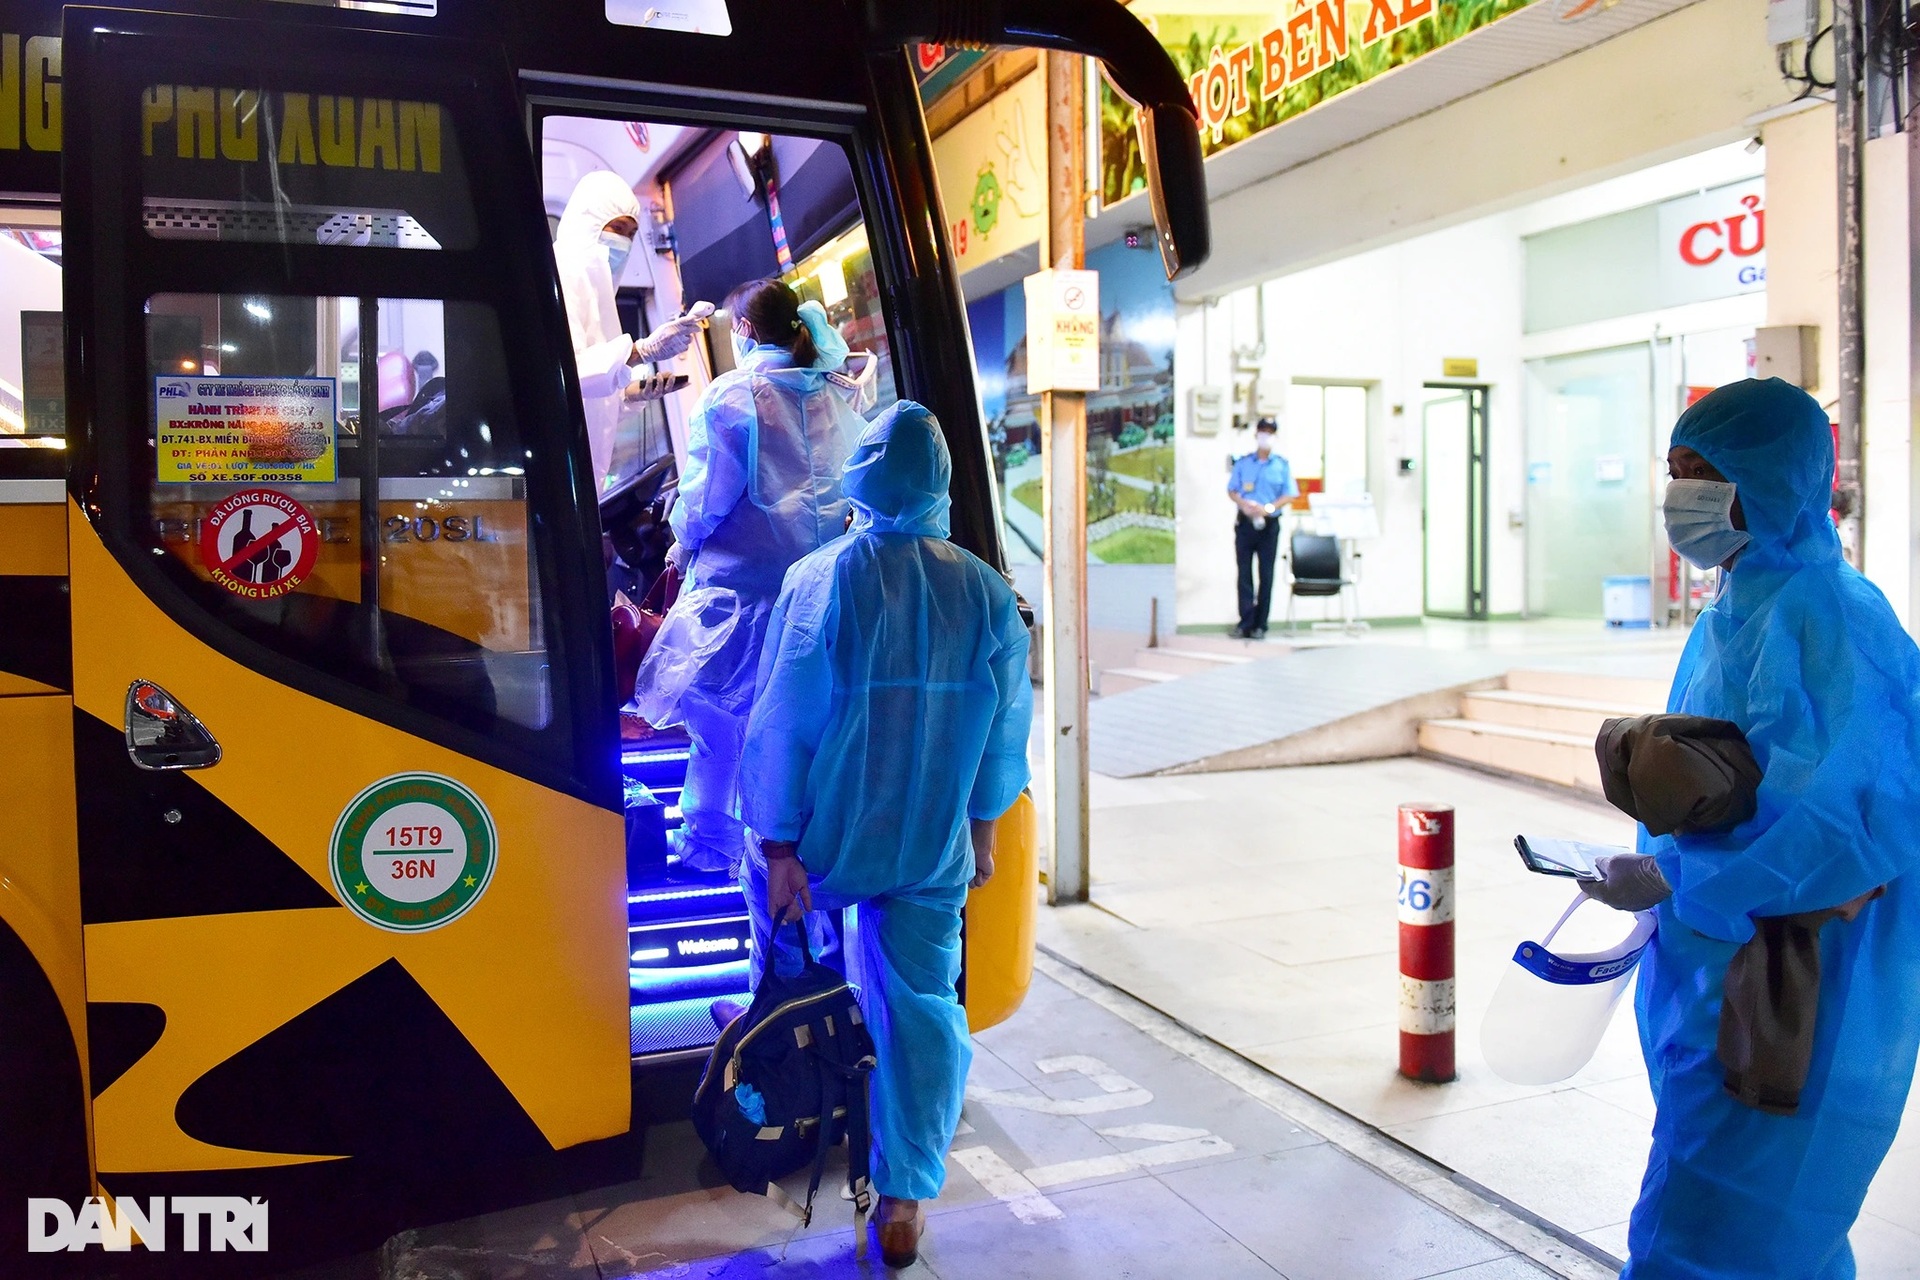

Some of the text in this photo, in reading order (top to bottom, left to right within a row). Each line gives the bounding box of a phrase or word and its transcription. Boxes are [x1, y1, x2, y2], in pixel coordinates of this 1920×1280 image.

[188, 402, 221, 415] HÀNH
[189, 471, 302, 481] SỐ XE.50F-00358
[211, 509, 226, 526] ĐÃ
[224, 493, 260, 511] UỐNG
[296, 514, 312, 534] BIA
[212, 568, 301, 598] KHÔNG LÁI XE
[386, 826, 442, 846] 15T9
[391, 859, 435, 879] 36N
[1595, 965, 1621, 975] Face
